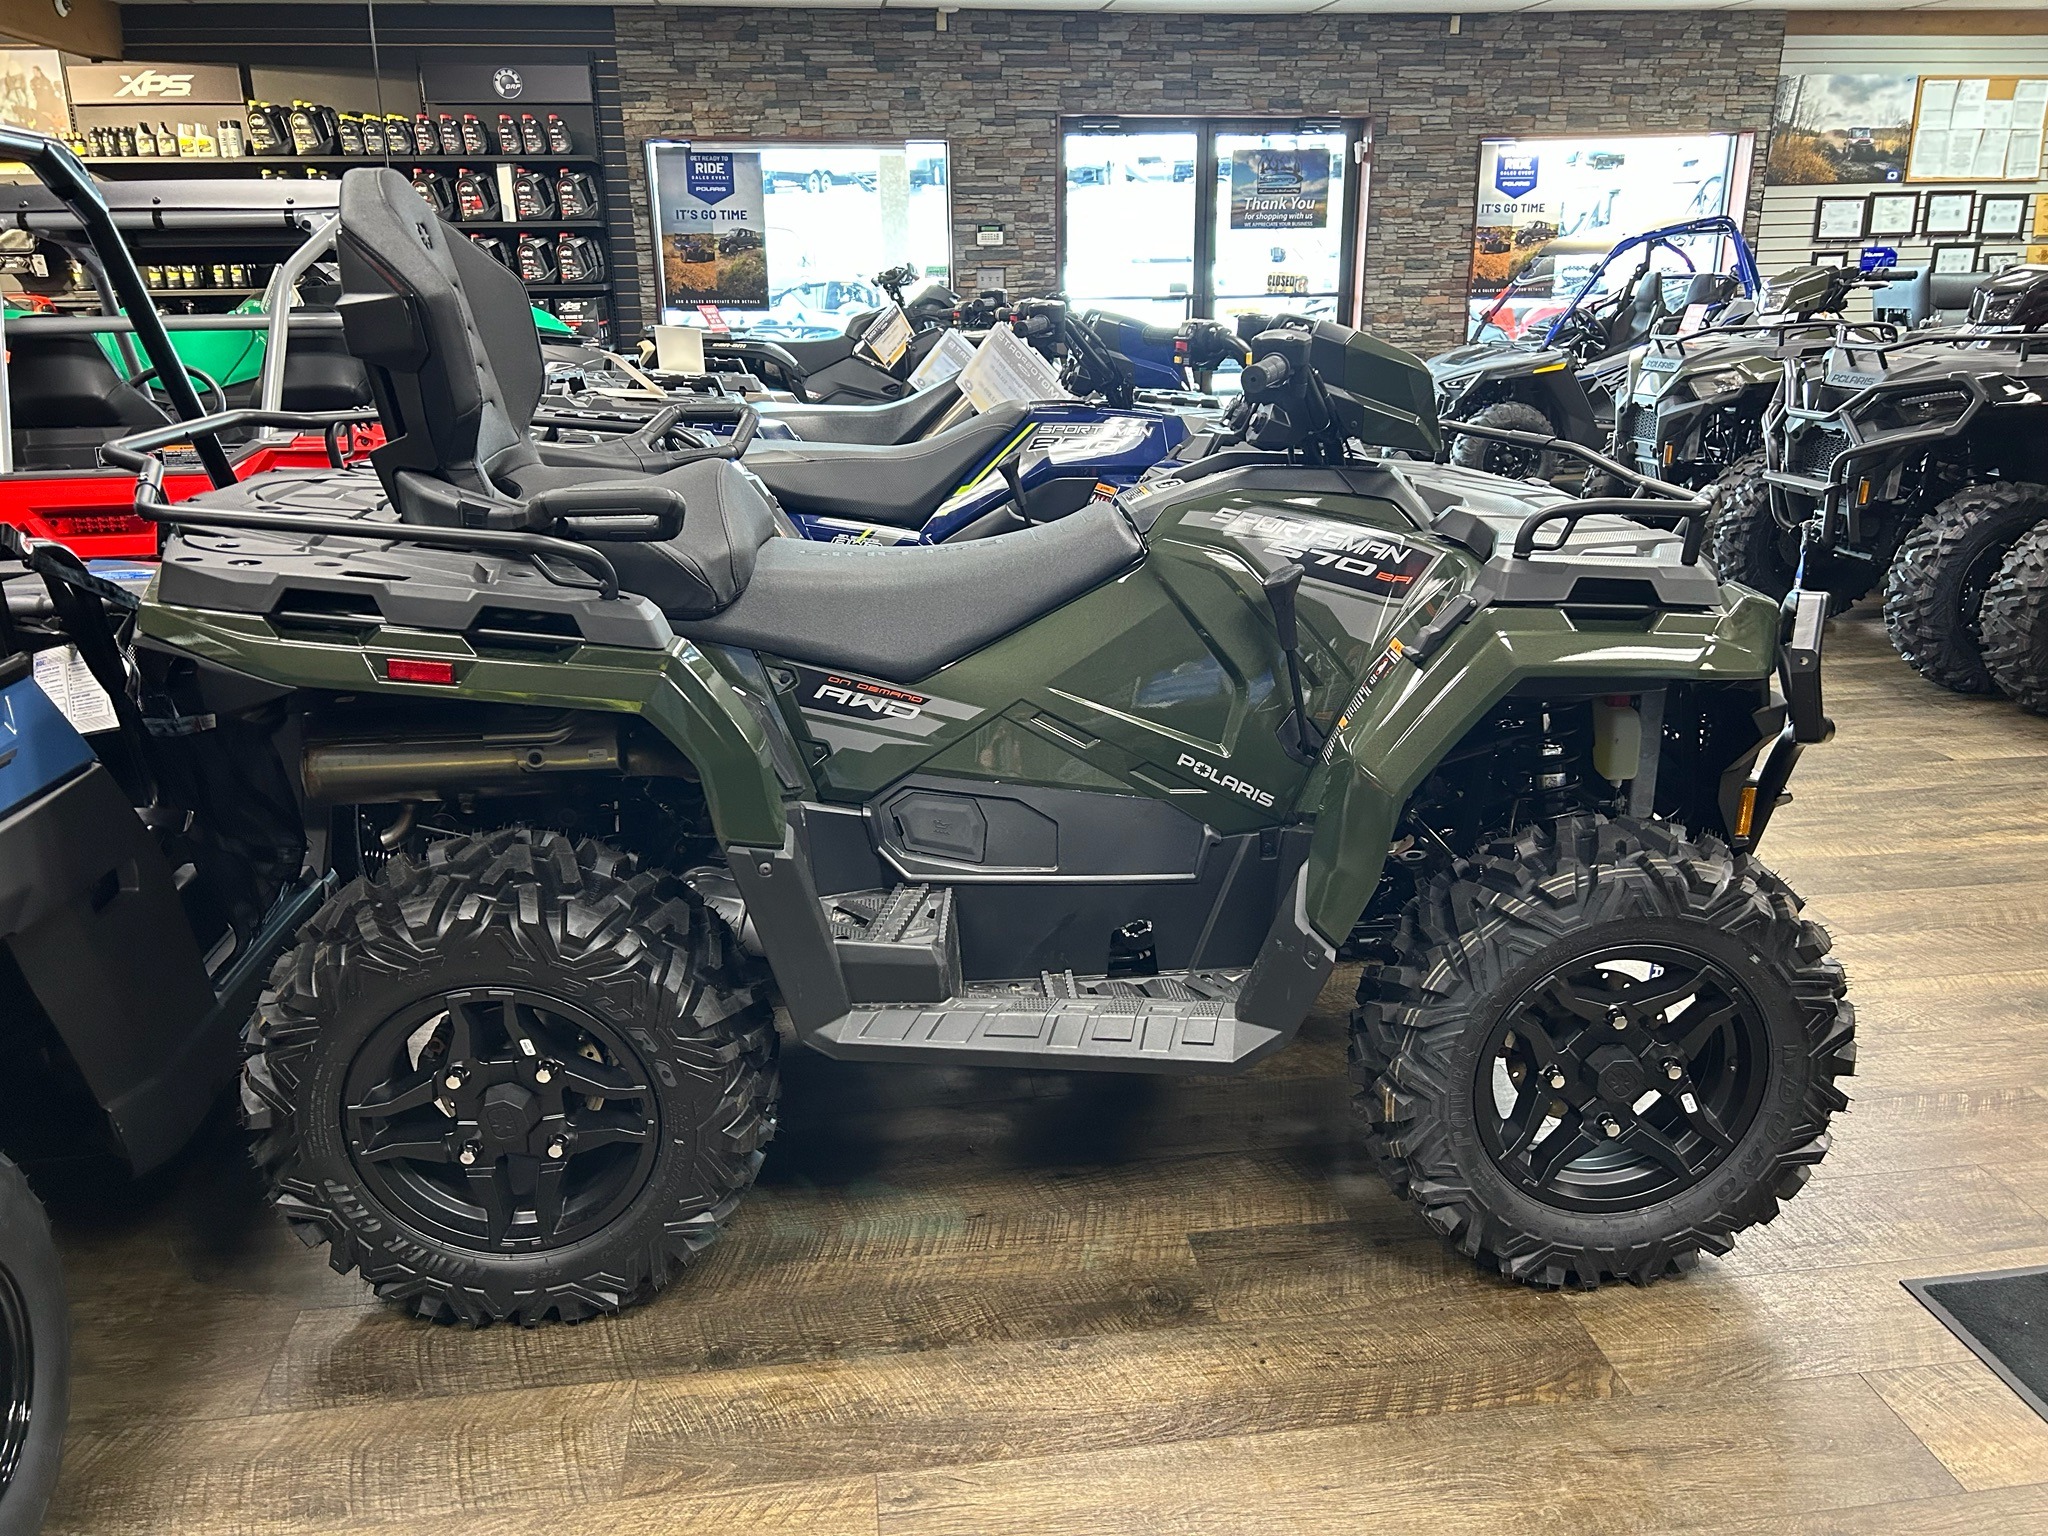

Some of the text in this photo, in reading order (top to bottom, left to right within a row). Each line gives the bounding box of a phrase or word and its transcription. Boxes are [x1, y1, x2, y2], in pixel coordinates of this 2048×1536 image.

[113, 69, 195, 97] XPS
[695, 163, 725, 174] RIDE
[1244, 196, 1316, 210] Thank You
[1481, 203, 1546, 214] IT'S GO TIME
[676, 210, 748, 220] IT'S GO TIME
[1244, 212, 1255, 220] for
[1256, 212, 1288, 222] shopping
[1288, 212, 1304, 220] with
[1267, 274, 1295, 286] CLOSED
[558, 302, 582, 311] XPS
[1646, 360, 1676, 370] POLARIS
[1831, 374, 1875, 386] POLARIS
[1210, 506, 1412, 564] SPORTSMAN
[1264, 543, 1377, 577] 570
[1376, 571, 1414, 584] EFI
[828, 676, 923, 704] ON DEMAND
[813, 684, 922, 720] AWD
[1176, 752, 1275, 809] POLARIS
